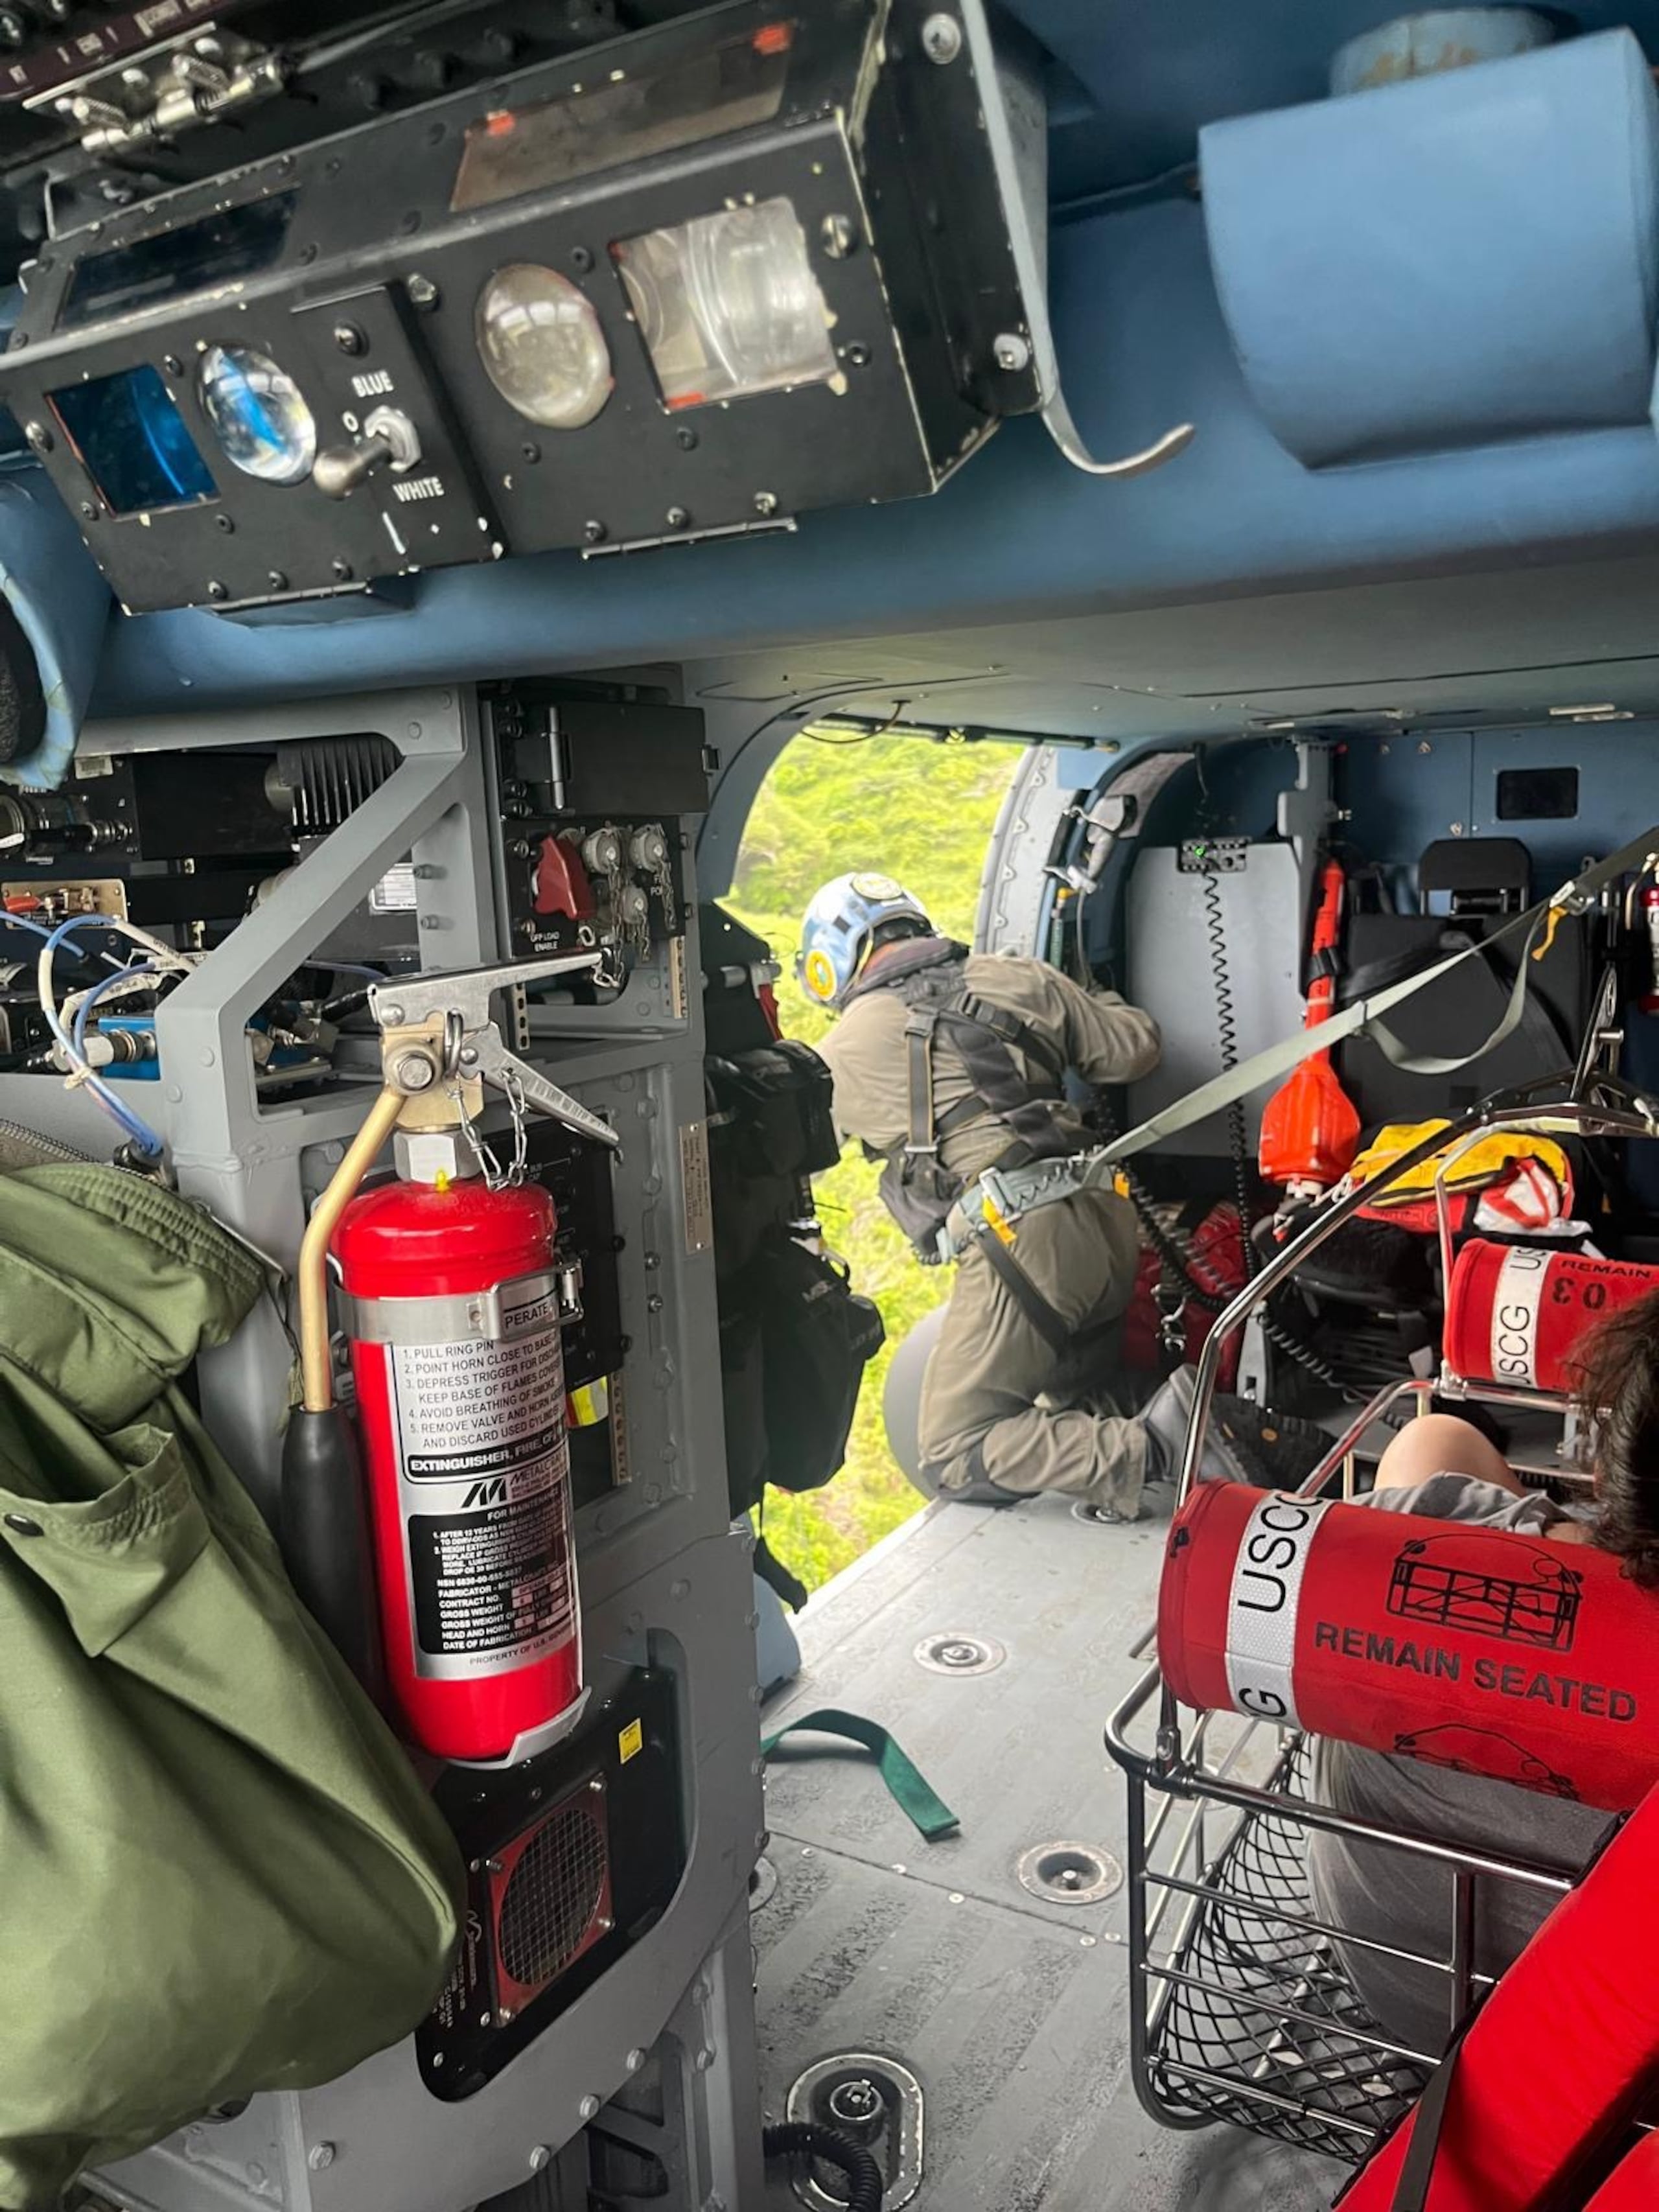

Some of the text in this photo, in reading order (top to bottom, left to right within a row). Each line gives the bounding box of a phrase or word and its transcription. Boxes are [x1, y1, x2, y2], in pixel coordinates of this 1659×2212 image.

[351, 369, 394, 398] BLUE
[392, 476, 445, 502] WHITE
[534, 942, 558, 952] ENABLE
[1560, 1259, 1651, 1279] REMAIN
[504, 1303, 549, 1329] PERATE
[404, 1340, 494, 1360] 1. PULL RING PIN
[405, 1363, 413, 1374] 2.
[416, 1362, 448, 1374] POINT
[452, 1356, 484, 1371] HORN
[488, 1347, 520, 1366] CLOSE
[523, 1343, 533, 1356] TO
[406, 1380, 413, 1390] 3.
[417, 1375, 469, 1390] DEPRESS
[472, 1363, 518, 1383] TRIGGER
[520, 1357, 537, 1371] FOR
[409, 1378, 555, 1419] 4. AVOID BREATHING OF SMOKE
[419, 1393, 448, 1404] KEEP
[451, 1388, 481, 1402] BASE
[485, 1384, 498, 1396] OF
[502, 1374, 537, 1391] FLAMES
[410, 1423, 419, 1434] 5.
[421, 1419, 468, 1434] REMOVE
[471, 1412, 505, 1429] VALVE
[507, 1406, 526, 1421] AND
[528, 1399, 550, 1415] HORN
[423, 1437, 447, 1449] AND
[449, 1428, 499, 1447] DISCARD
[500, 1421, 528, 1438] USED
[410, 1449, 513, 1472] EXTINGUISHER,
[487, 1509, 507, 1522] FOR
[440, 1530, 463, 1539] AFTER
[474, 1524, 498, 1536] YEARS
[441, 1538, 451, 1546] TO
[441, 1551, 476, 1561] REPLACE
[437, 1579, 455, 1588] NSN
[437, 1585, 493, 1599] FABRICATOR
[439, 1596, 485, 1609] CONTRACT
[440, 1609, 470, 1619] GROSS
[470, 1603, 504, 1618] WEIGHT
[441, 1620, 470, 1630] GROSS
[472, 1614, 504, 1627] WEIGHT
[442, 1623, 510, 1640] HEAD AND HORN
[443, 1626, 533, 1650] DATE OF FABRICATION
[469, 1648, 518, 1664] PROPERTY
[520, 1645, 531, 1654] OF
[1314, 1621, 1637, 1722] REMAIN SEATED
